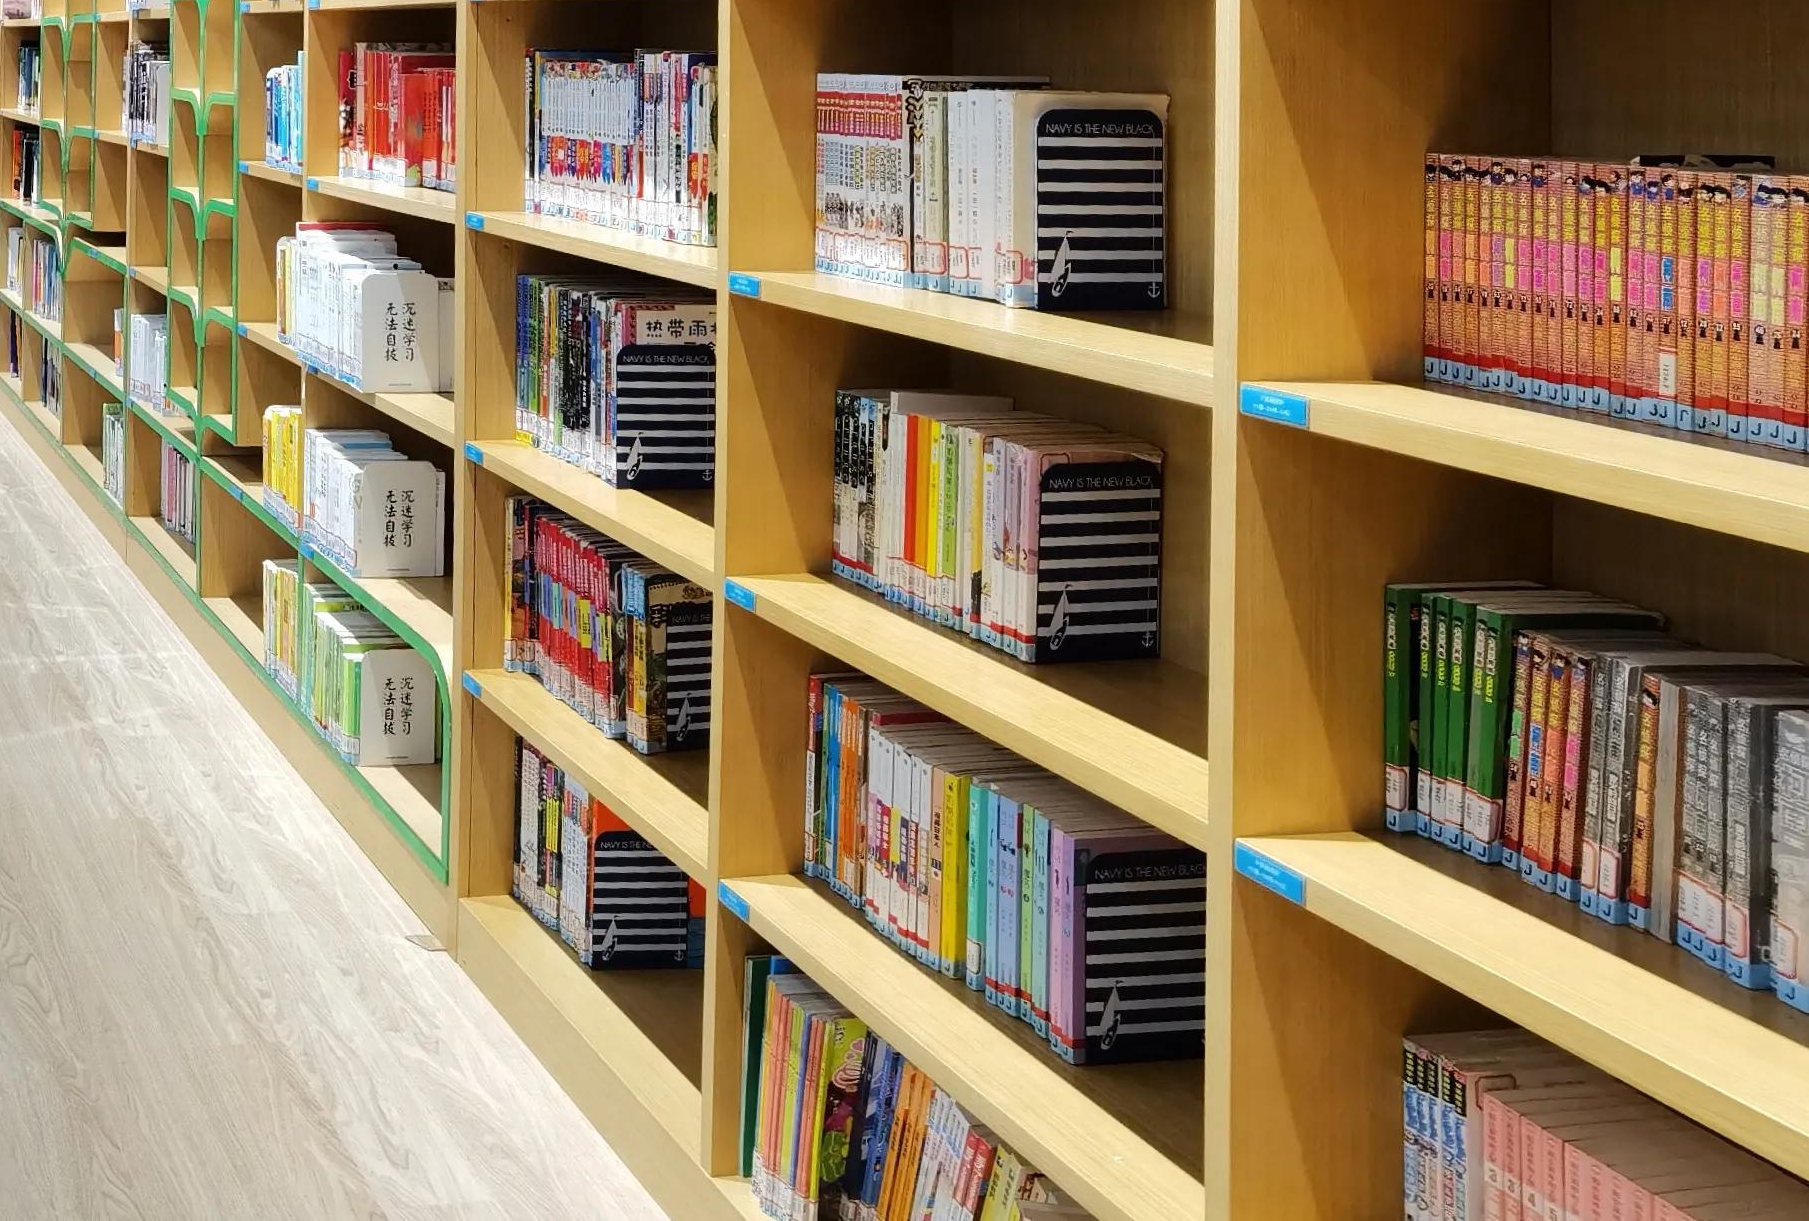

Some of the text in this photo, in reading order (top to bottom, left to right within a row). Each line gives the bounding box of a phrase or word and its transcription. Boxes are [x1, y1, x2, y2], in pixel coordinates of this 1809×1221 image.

[1046, 123, 1154, 134] NAVY IS THE NEW BLACK
[384, 302, 399, 362] 无法自拔
[401, 302, 417, 362] 沉迷学习
[622, 354, 645, 363] NAVY
[645, 355, 652, 363] IS
[666, 354, 686, 363] NEW
[1049, 478, 1074, 489] NAVY
[1076, 477, 1084, 488] IS
[1086, 477, 1101, 488] THE
[1102, 477, 1124, 487] NEW
[383, 490, 398, 548] 无法自拔
[400, 490, 414, 547] 沉迷学习
[382, 677, 397, 736] 无法自拔
[399, 676, 414, 735] 沉迷学习
[600, 841, 621, 849] NAVY
[1094, 867, 1123, 880] NAVY
